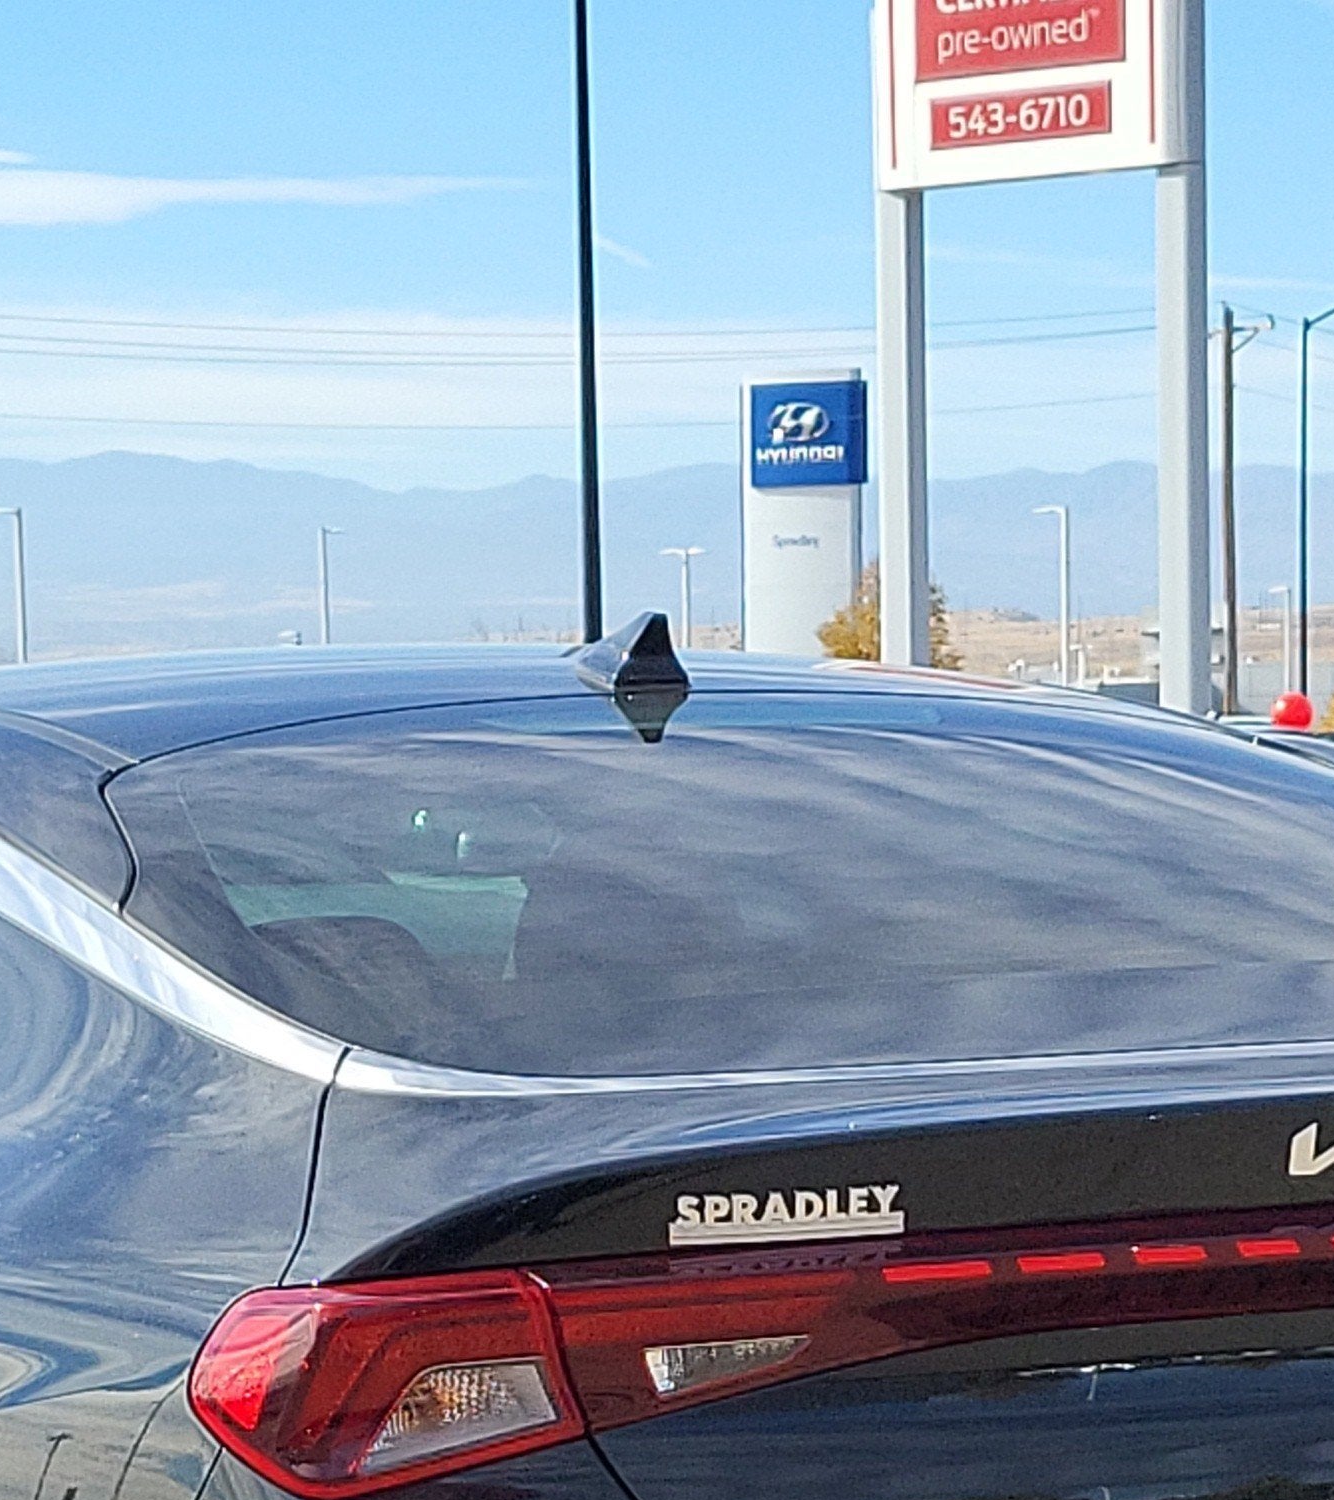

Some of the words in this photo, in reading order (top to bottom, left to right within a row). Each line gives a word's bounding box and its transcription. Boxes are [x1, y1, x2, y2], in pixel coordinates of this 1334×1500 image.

[948, 93, 1090, 139] 543-6710
[755, 445, 845, 465] HYUNDAI
[675, 1184, 901, 1228] SPRADLEY
